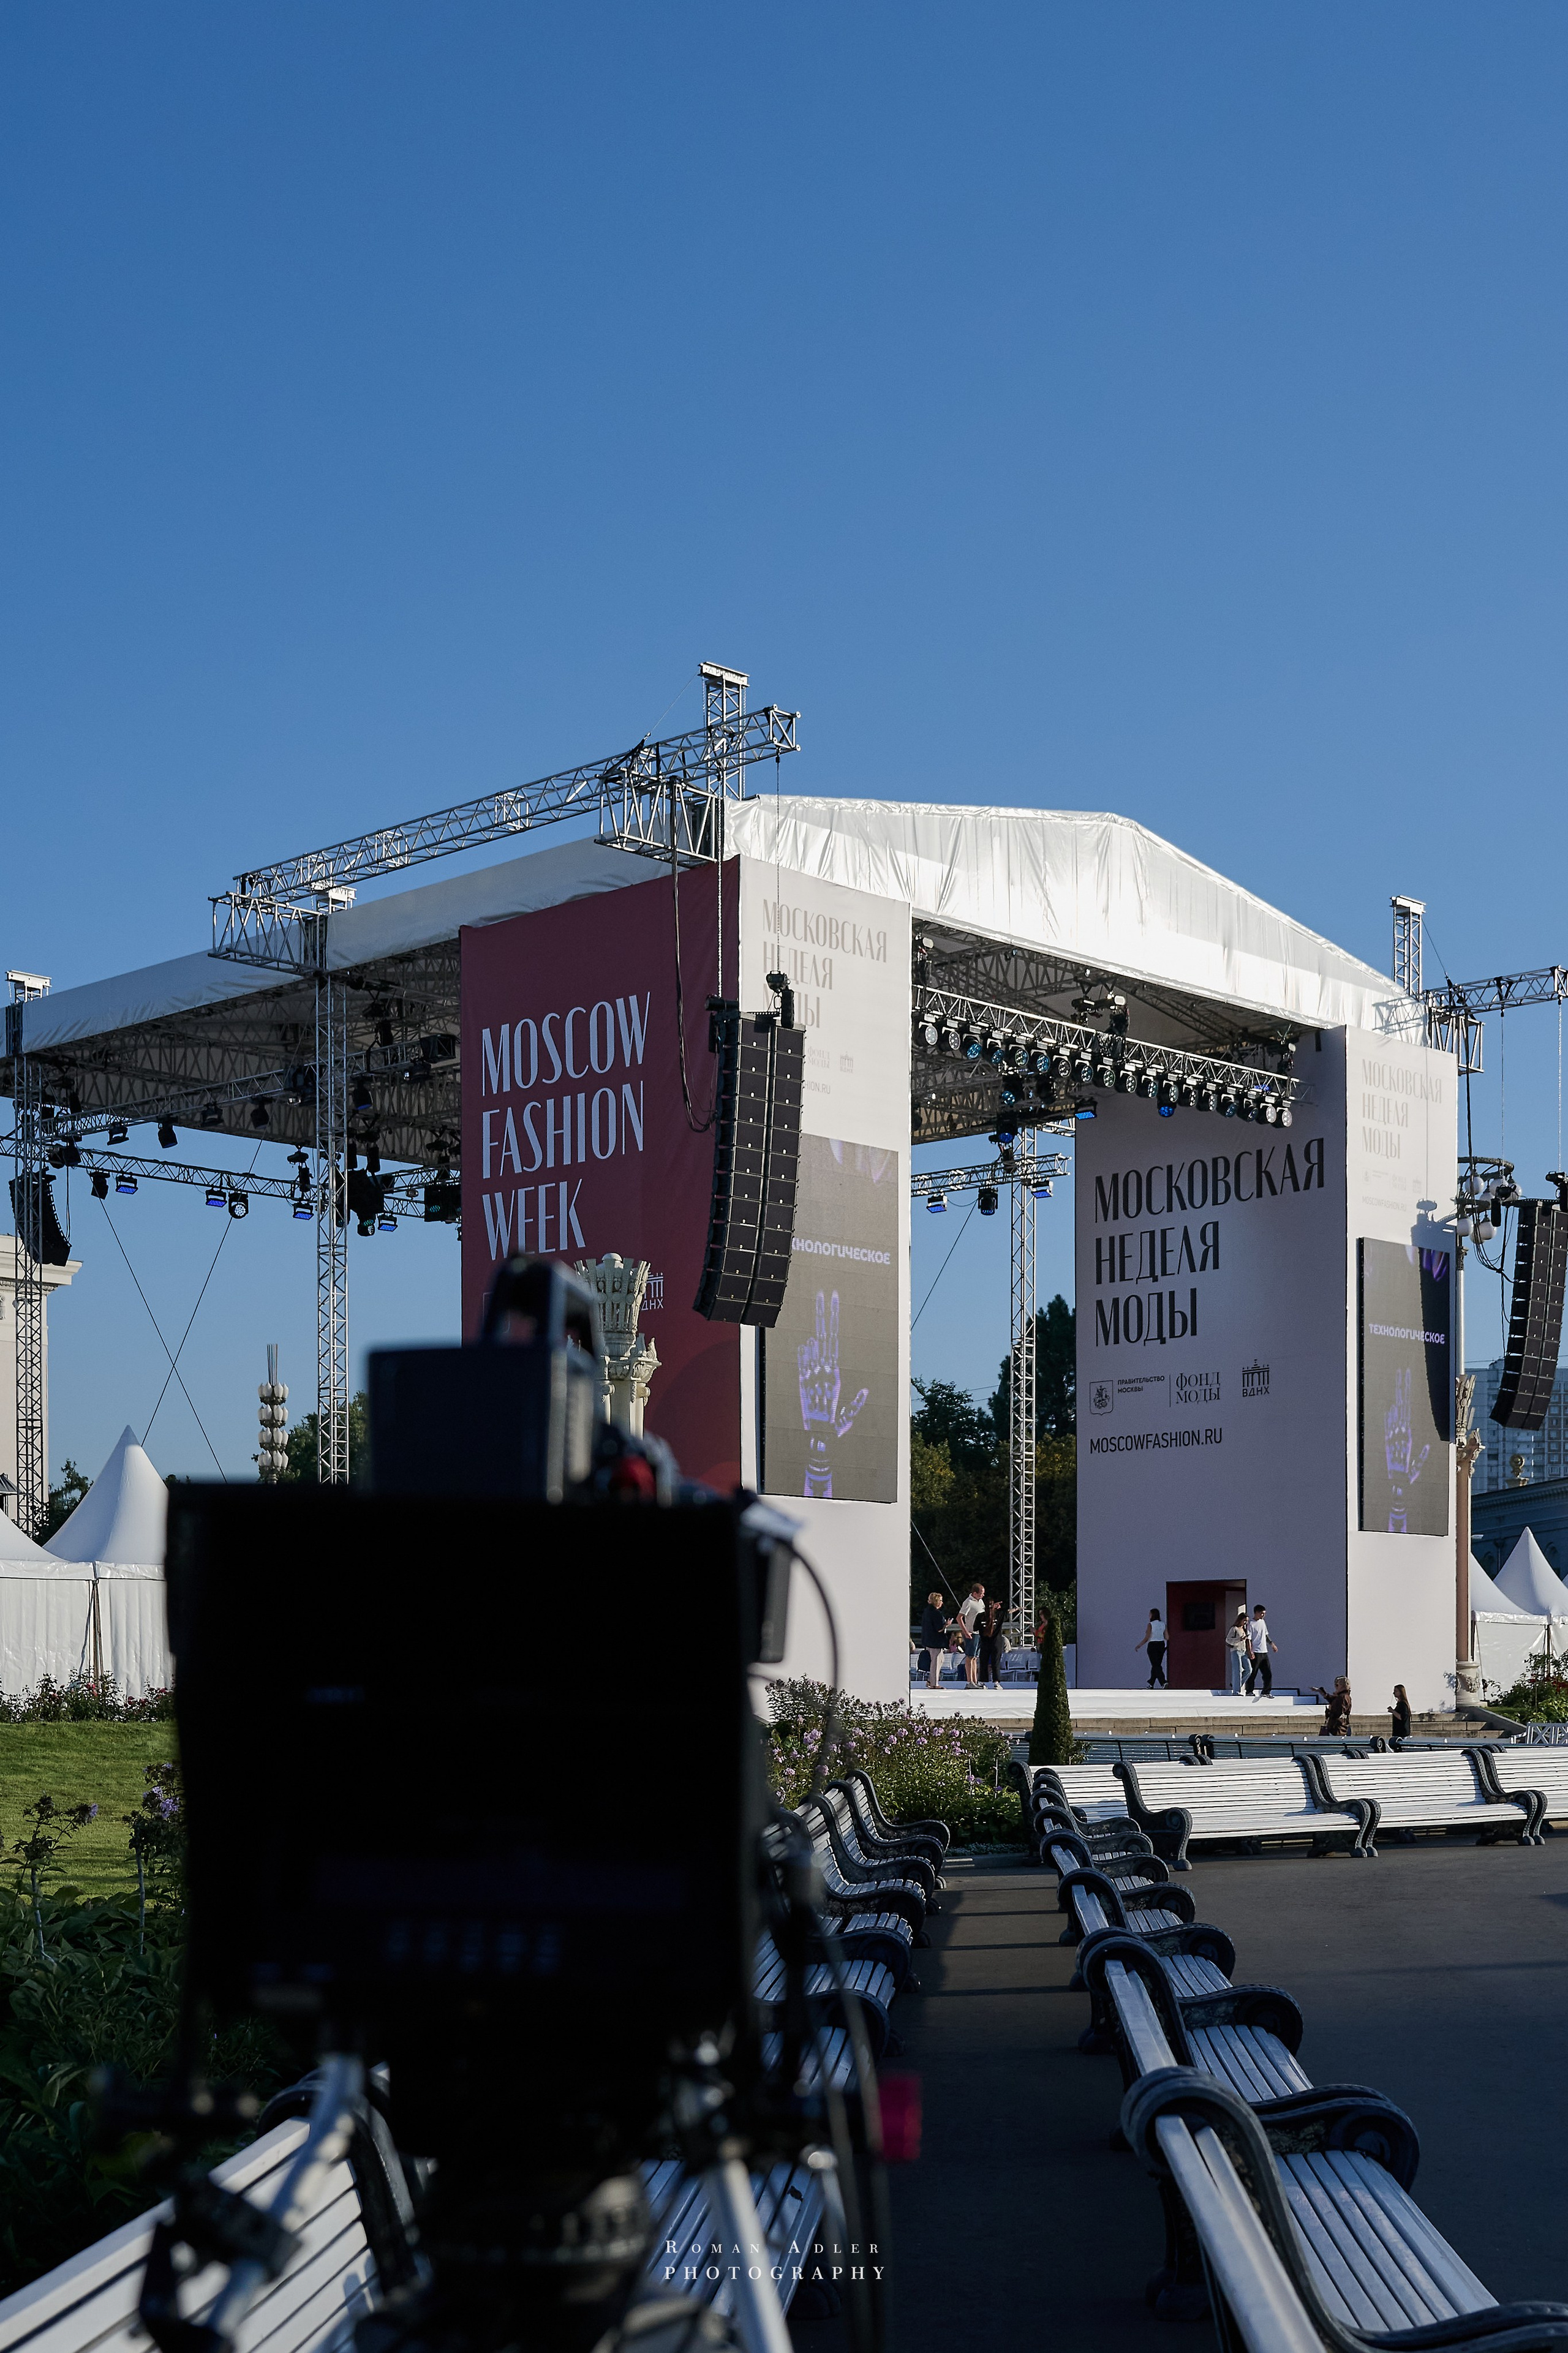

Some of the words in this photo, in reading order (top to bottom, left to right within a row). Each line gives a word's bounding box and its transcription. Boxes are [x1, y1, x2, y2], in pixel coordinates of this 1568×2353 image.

[763, 898, 887, 963] МОСКОВСКАЯ
[763, 984, 820, 1028] МДЫ
[482, 992, 651, 1096] MOSCOW
[1362, 1058, 1442, 1104] МОСКОВСКАЯ
[1362, 1092, 1409, 1128] НЕДЕЛЯ
[482, 1080, 644, 1178] FASHION
[1362, 1126, 1401, 1159] МОДЫ
[1095, 1137, 1325, 1224] МОСКОВСКАЯ
[482, 1179, 586, 1262] WEEK
[791, 1237, 890, 1265] ХНОЛОГИЧЕСКОЕ
[1095, 1221, 1220, 1285] НЕДЕЛЯ
[641, 1298, 663, 1311] ДНХ
[1095, 1287, 1198, 1347] МОДЫ
[1369, 1323, 1446, 1344] ТЕХНОЛОГИЧЕСКОЕ
[1117, 1375, 1165, 1387] ПРАВИТЕЛЬСТВО
[1117, 1385, 1144, 1393] МОСКВЫ
[1175, 1372, 1221, 1391] ФОНД
[1175, 1386, 1221, 1405] МОДЫ
[1242, 1387, 1270, 1397] ВДНХ
[1090, 1428, 1223, 1453] MOSCOWFASHION.RU
